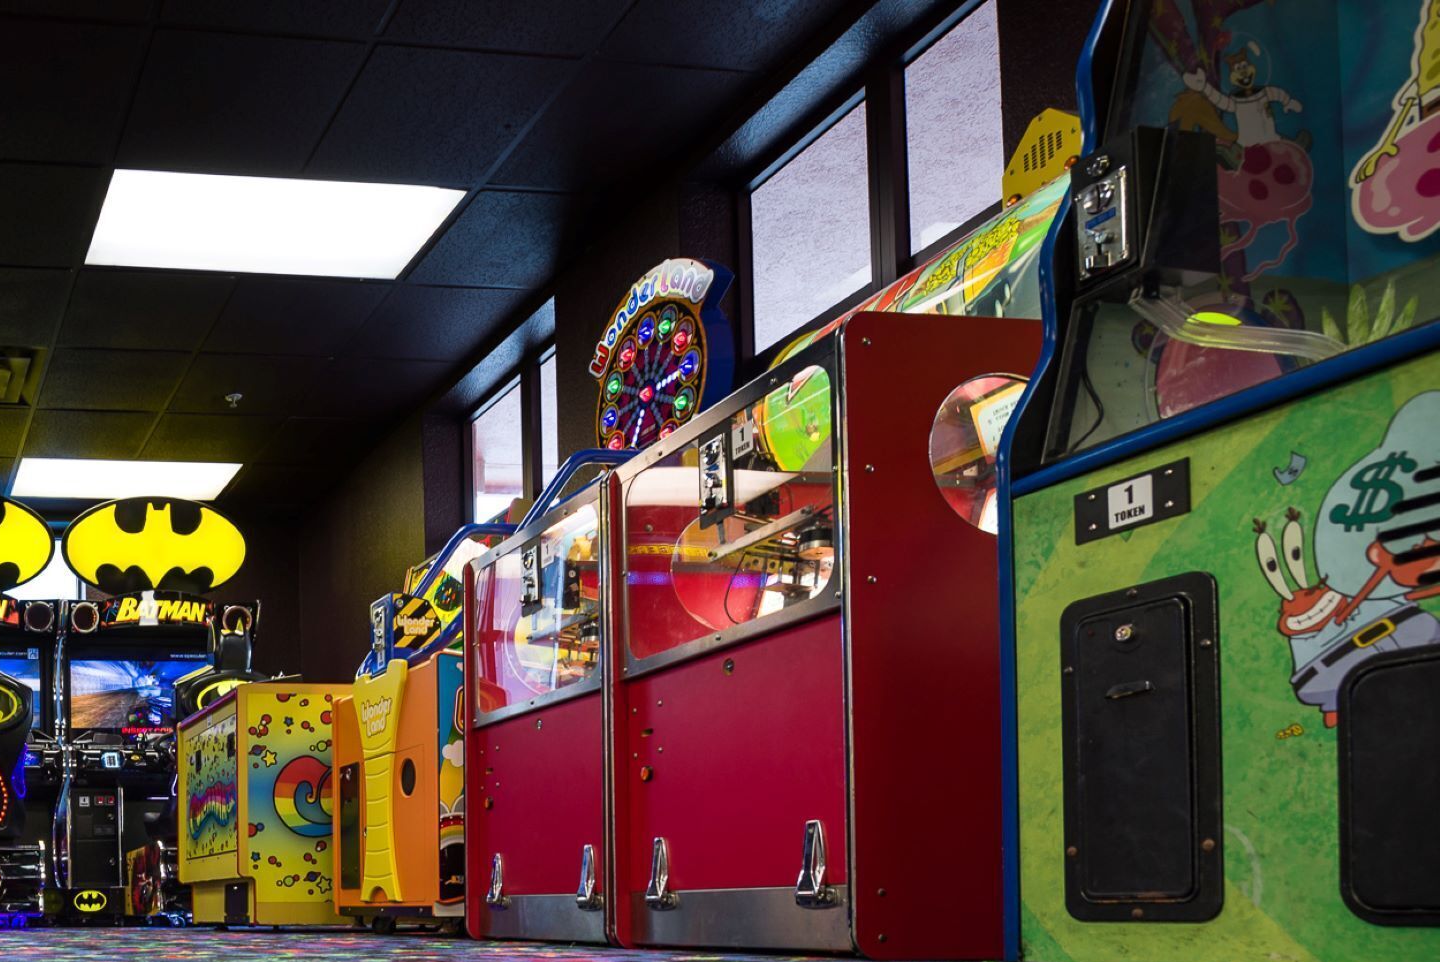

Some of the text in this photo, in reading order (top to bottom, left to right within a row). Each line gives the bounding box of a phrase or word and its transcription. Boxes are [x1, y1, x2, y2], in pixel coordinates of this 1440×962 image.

[739, 427, 745, 442] 1
[1124, 484, 1134, 505] 1
[1114, 505, 1146, 523] TOKEN
[115, 597, 206, 622] BATMAN
[395, 614, 435, 628] Wonder
[403, 625, 429, 636] Land
[361, 696, 392, 724] Wonder
[366, 713, 387, 738] Land
